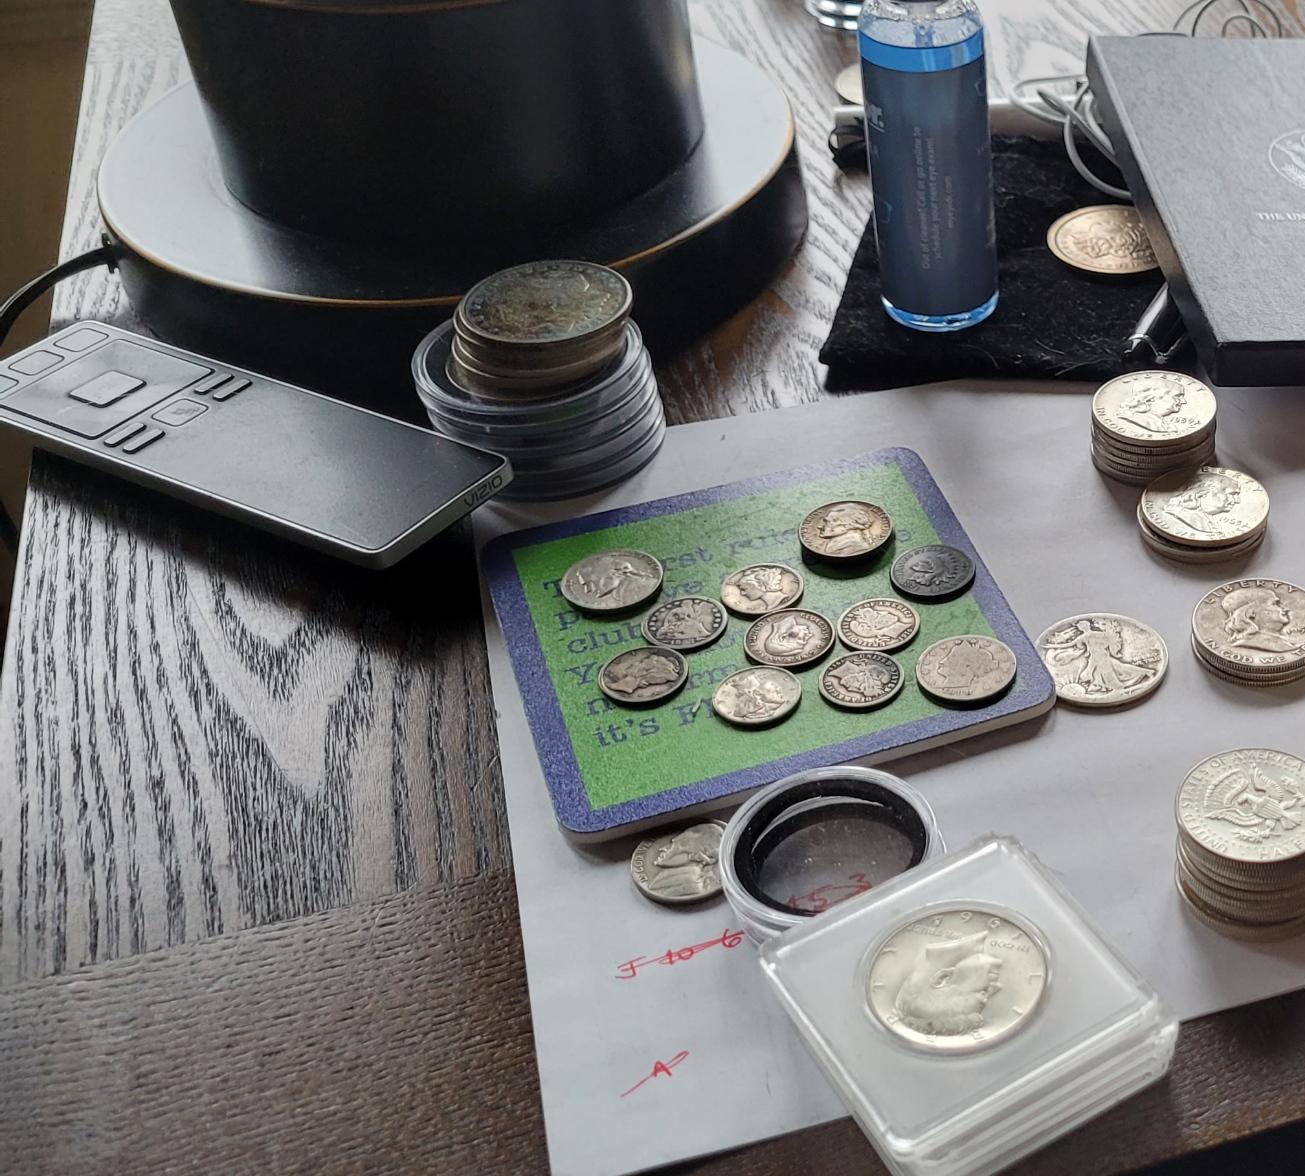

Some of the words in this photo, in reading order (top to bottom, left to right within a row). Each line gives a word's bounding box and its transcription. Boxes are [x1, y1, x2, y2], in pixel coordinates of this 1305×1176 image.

[1257, 212, 1285, 221] THE
[463, 475, 503, 506] VIZIO
[1203, 579, 1299, 606] LIBERTY
[1220, 649, 1254, 664] GOD
[1259, 656, 1287, 664] WE
[594, 716, 660, 748] it's
[1209, 755, 1227, 768] OF
[1233, 750, 1304, 773] AMERICA
